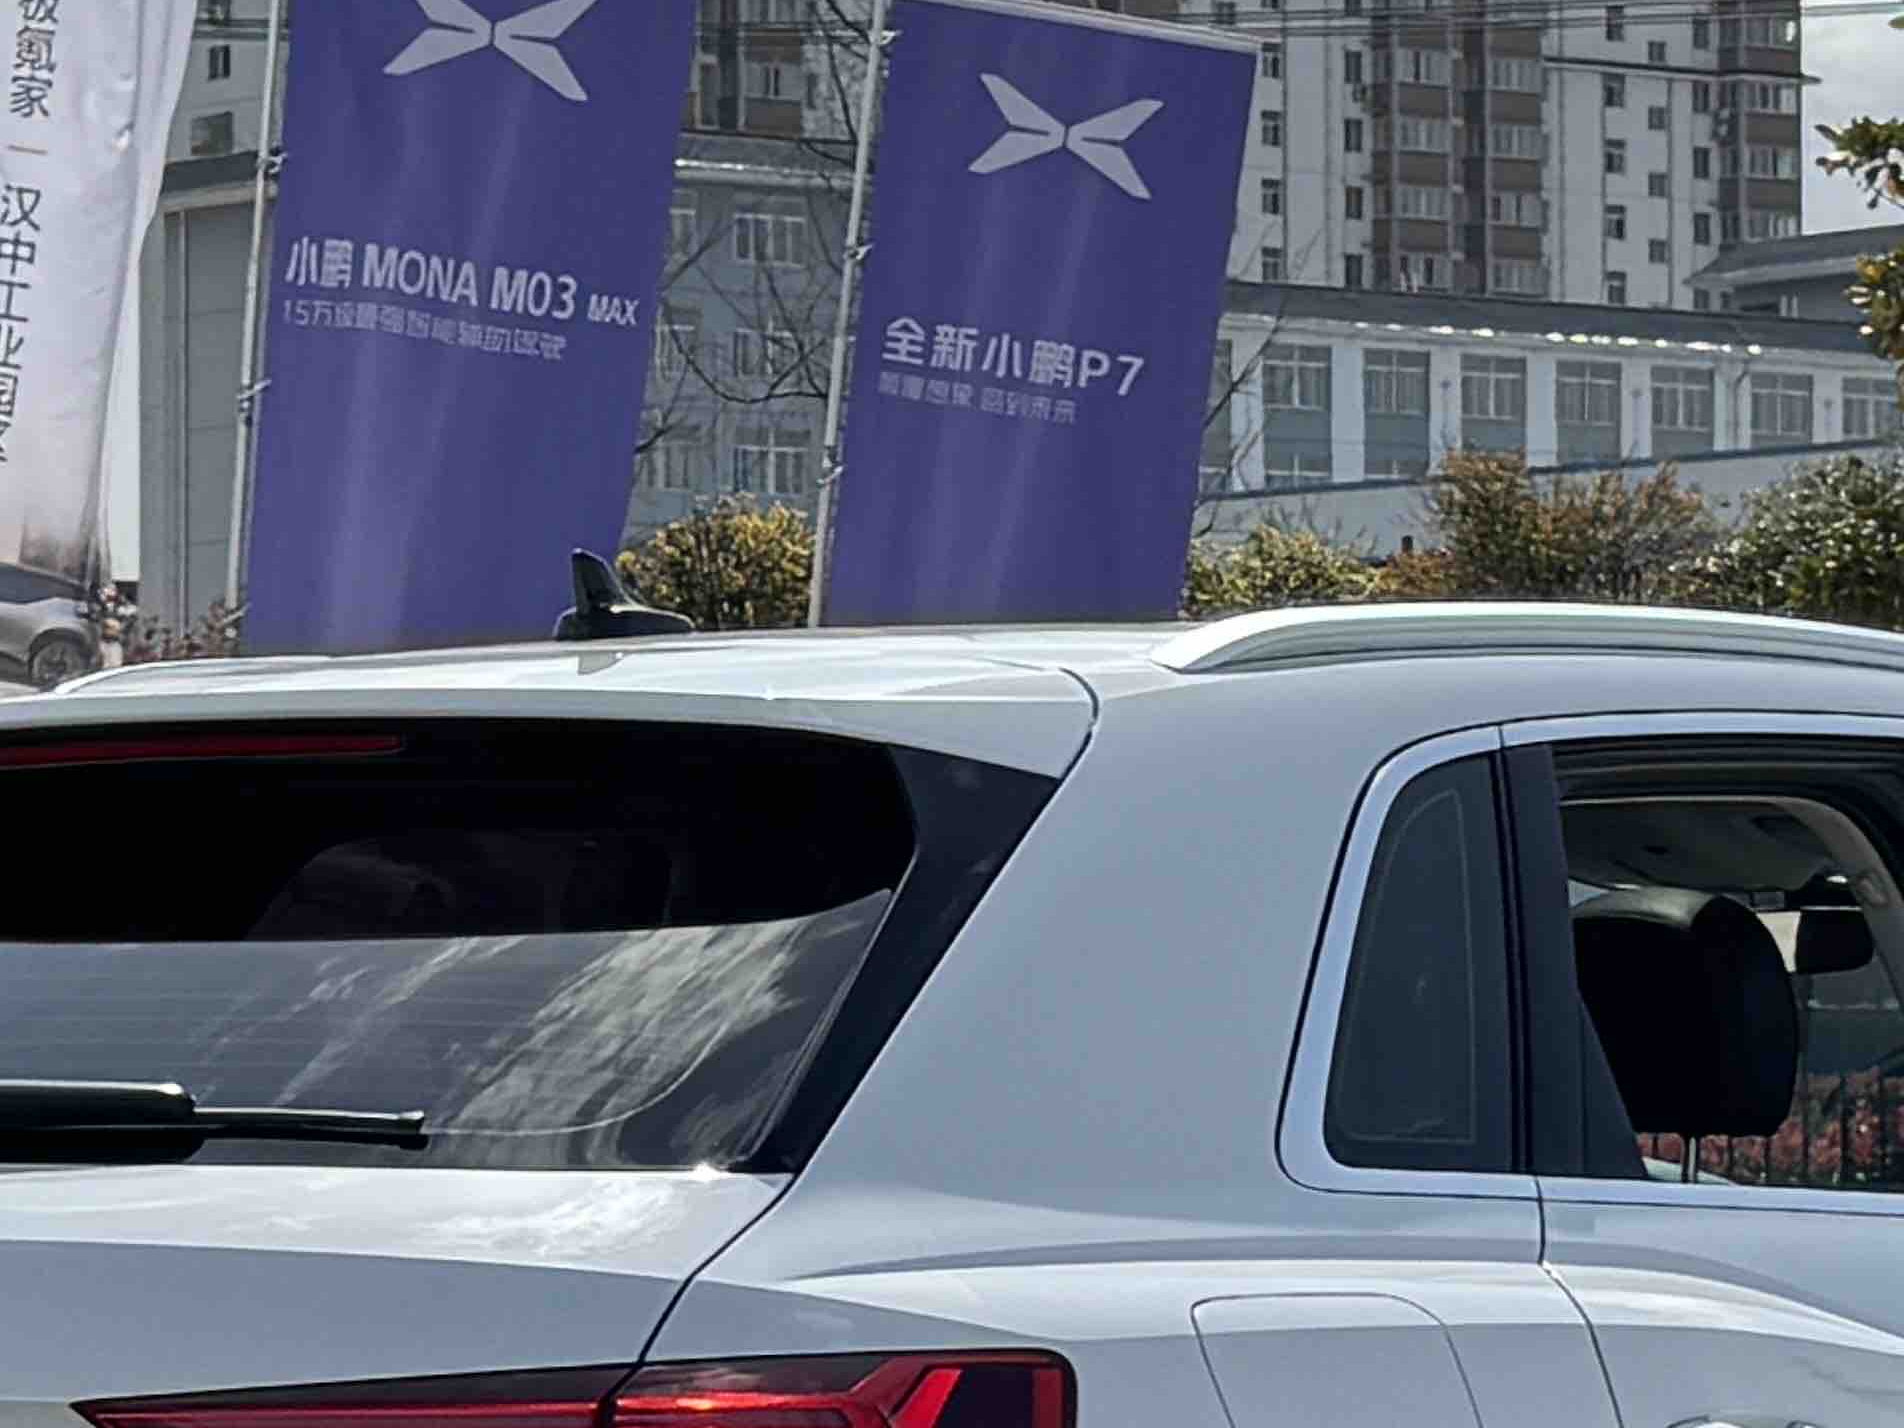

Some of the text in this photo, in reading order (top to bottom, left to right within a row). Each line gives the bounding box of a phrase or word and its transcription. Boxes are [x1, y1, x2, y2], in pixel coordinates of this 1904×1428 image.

[361, 243, 478, 308] MONA
[489, 266, 578, 321] M03
[586, 292, 641, 327] MAX
[881, 316, 1145, 398] 全新小鹏P7
